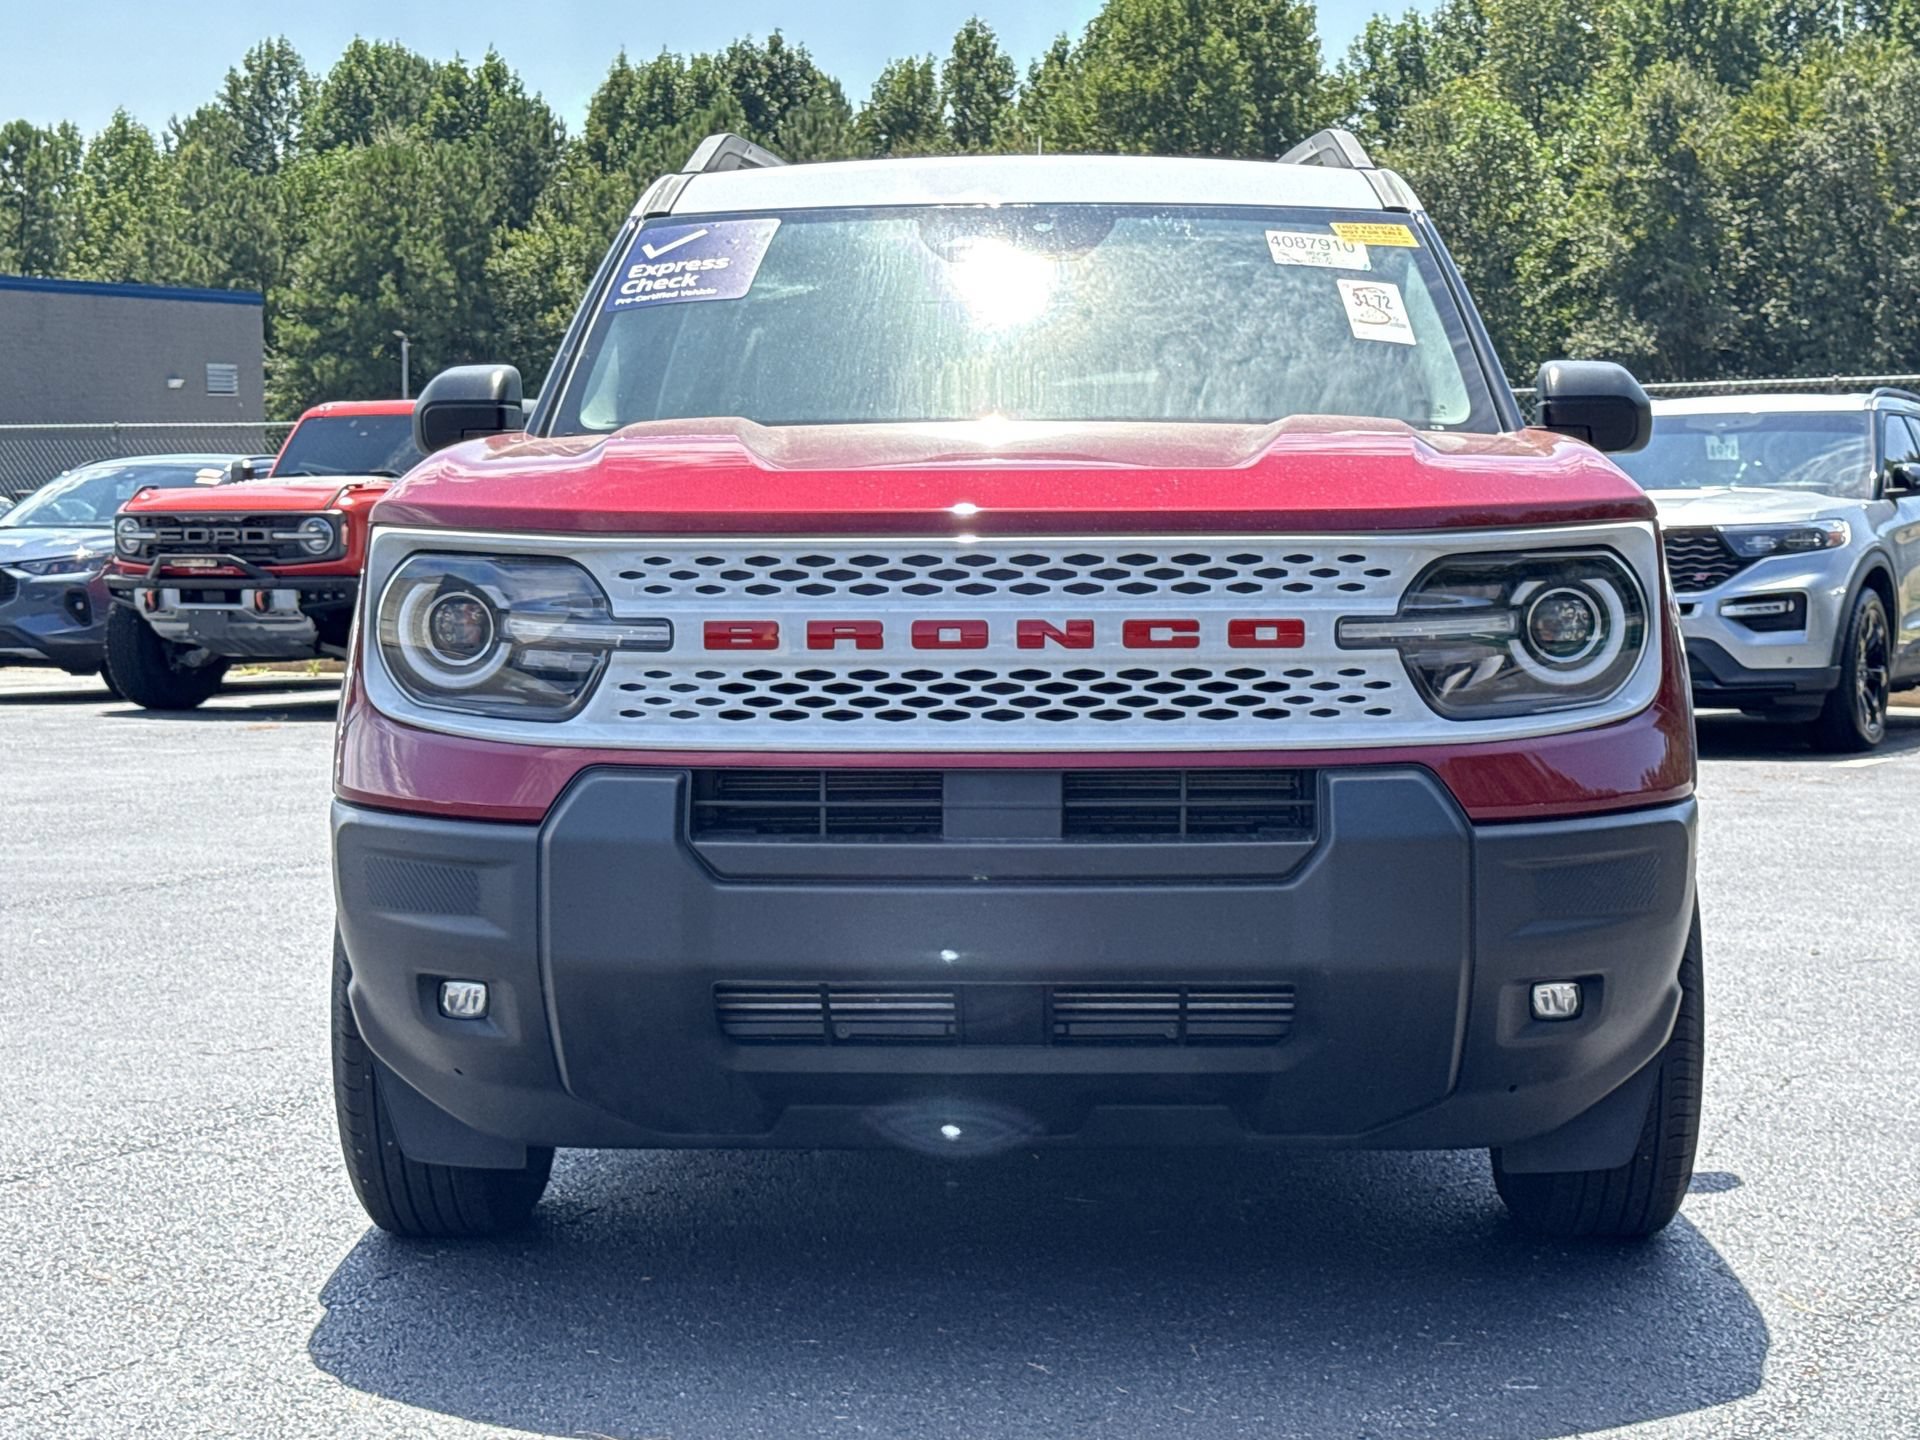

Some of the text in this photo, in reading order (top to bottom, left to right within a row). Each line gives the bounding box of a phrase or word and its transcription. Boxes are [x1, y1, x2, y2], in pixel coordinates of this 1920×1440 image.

[1270, 235, 1356, 254] 4087910
[627, 257, 731, 279] Express
[620, 273, 700, 296] Check
[614, 287, 718, 306] Pre-Certified Vehicle
[155, 527, 271, 545] FORD
[703, 619, 1305, 650] BRONCO
